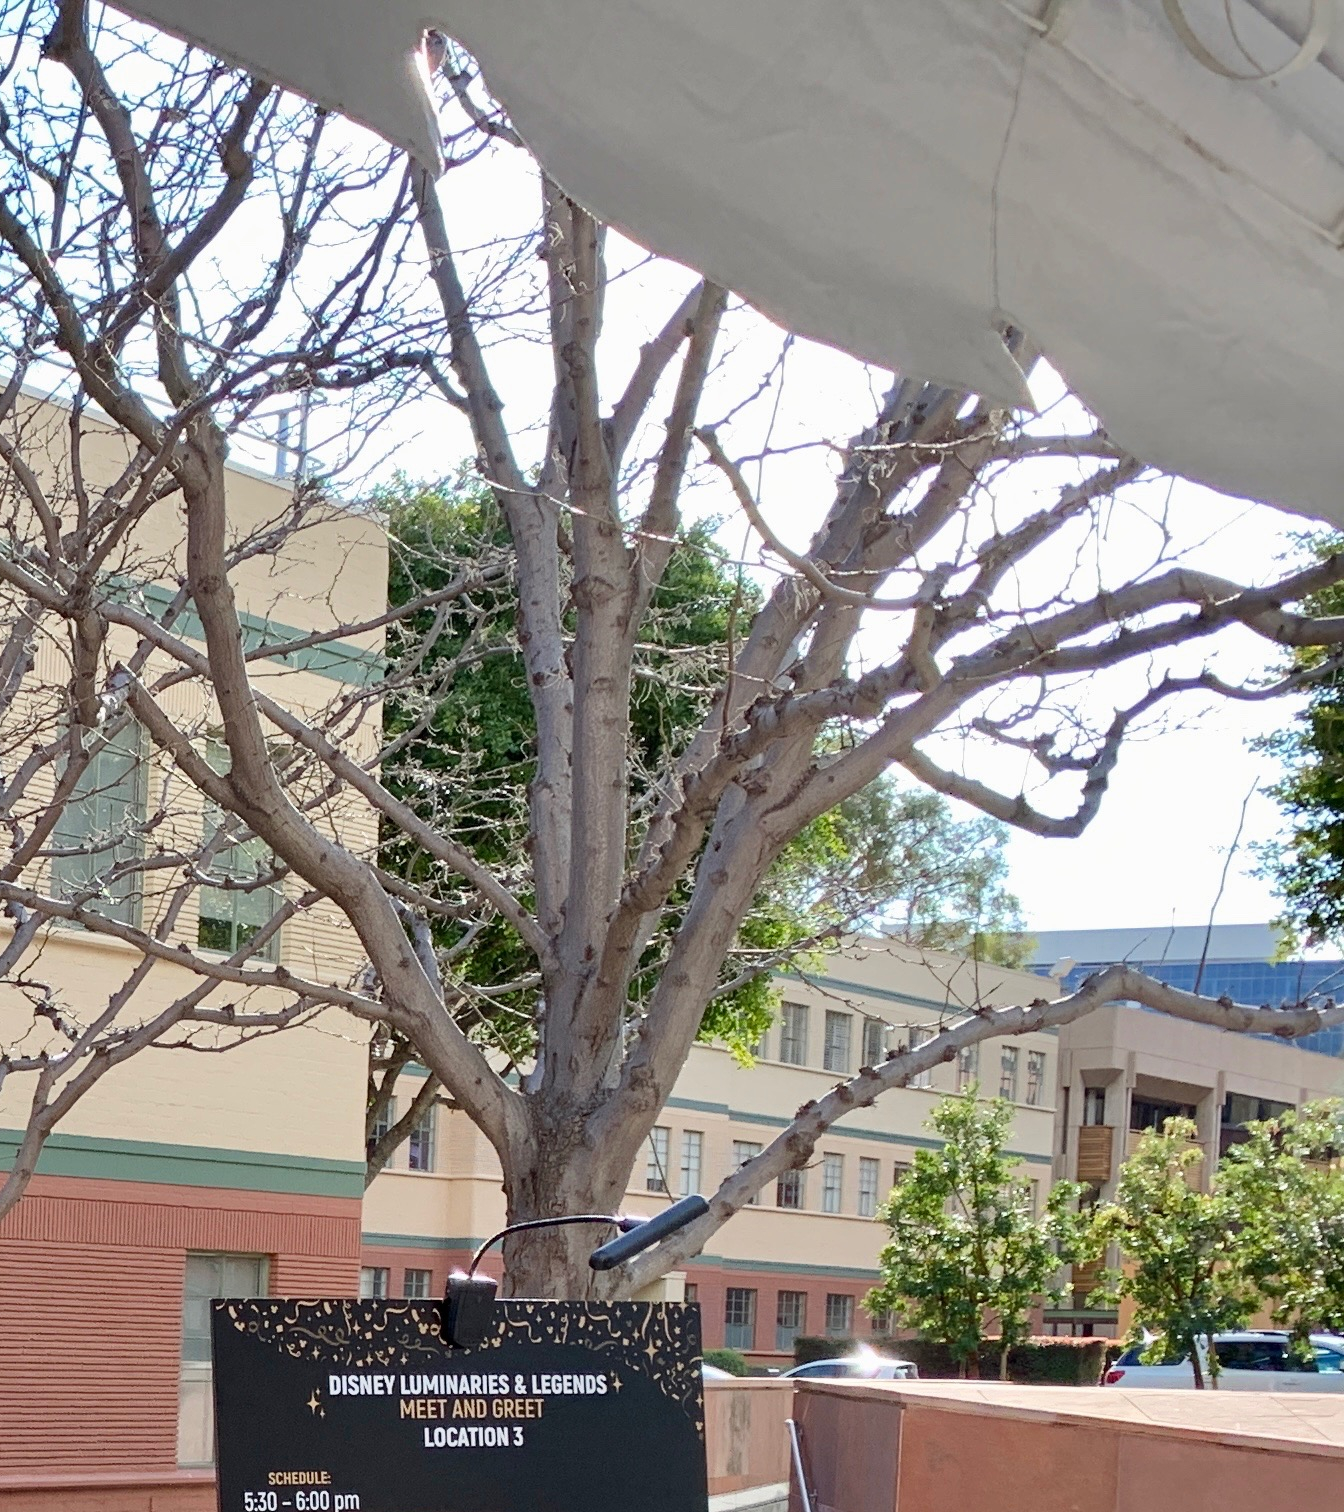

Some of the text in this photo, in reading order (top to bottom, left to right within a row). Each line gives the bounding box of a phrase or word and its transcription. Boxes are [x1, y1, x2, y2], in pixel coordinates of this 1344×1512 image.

[328, 1373, 608, 1397] DISNEY LUMINARIES & LEGENDS
[399, 1398, 545, 1420] MEET AND GREET
[423, 1426, 524, 1449] LOCATION 3
[267, 1470, 332, 1487] SCHEDULE:
[294, 1489, 329, 1512] 6:00
